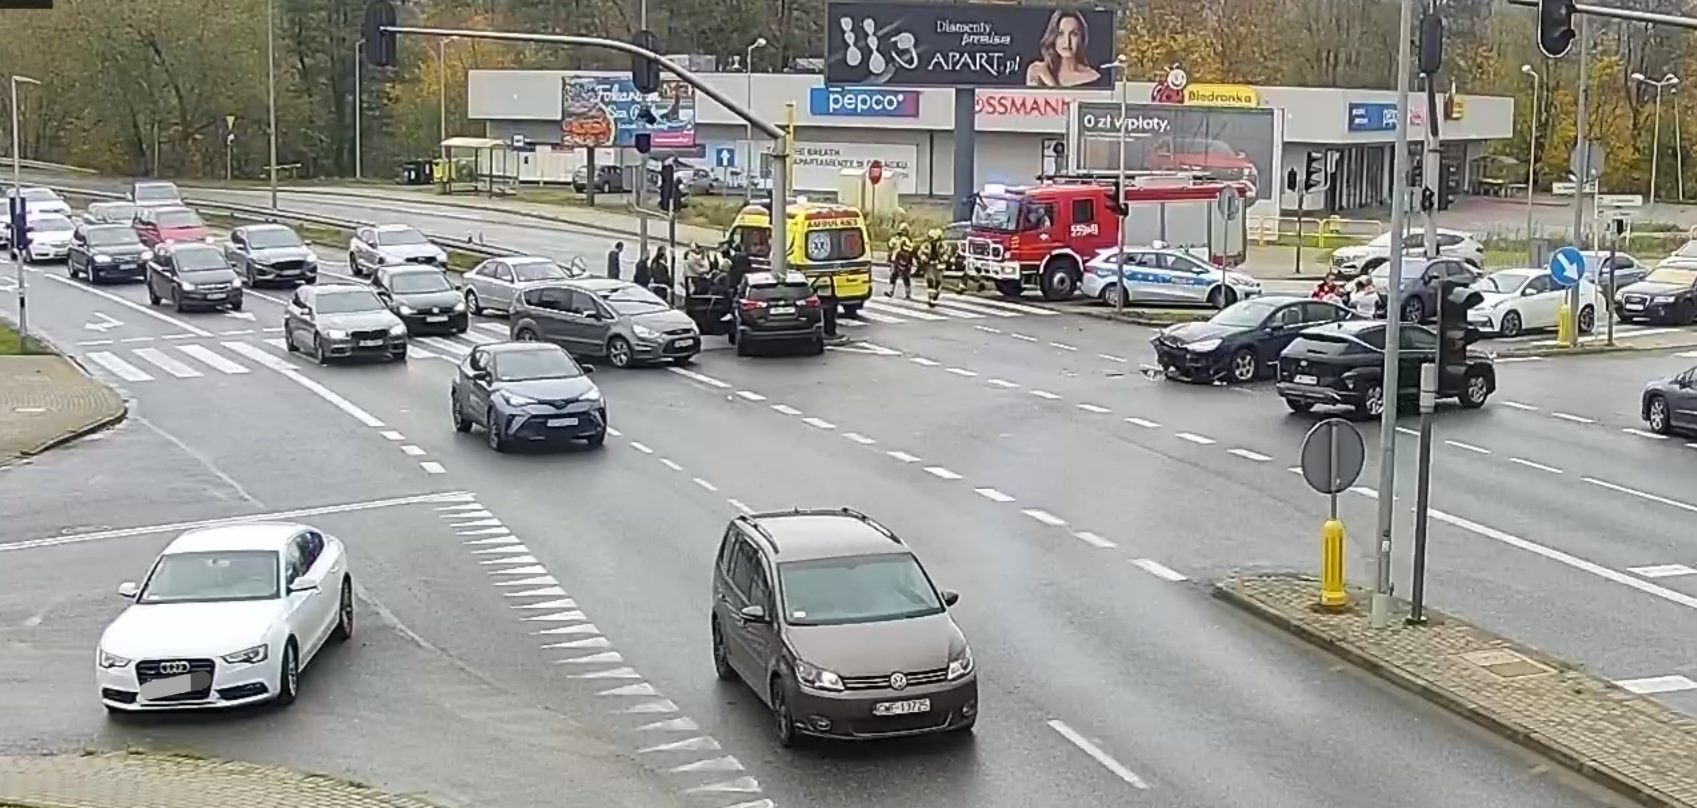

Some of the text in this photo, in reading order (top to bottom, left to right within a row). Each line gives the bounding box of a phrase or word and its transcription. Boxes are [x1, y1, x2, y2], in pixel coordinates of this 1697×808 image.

[936, 19, 992, 34] Diamenty
[927, 52, 1020, 76] APART.pl
[829, 93, 898, 113] pepco
[1188, 90, 1252, 103] Biedronka
[1083, 114, 1095, 128] 0
[1097, 114, 1111, 129] zł
